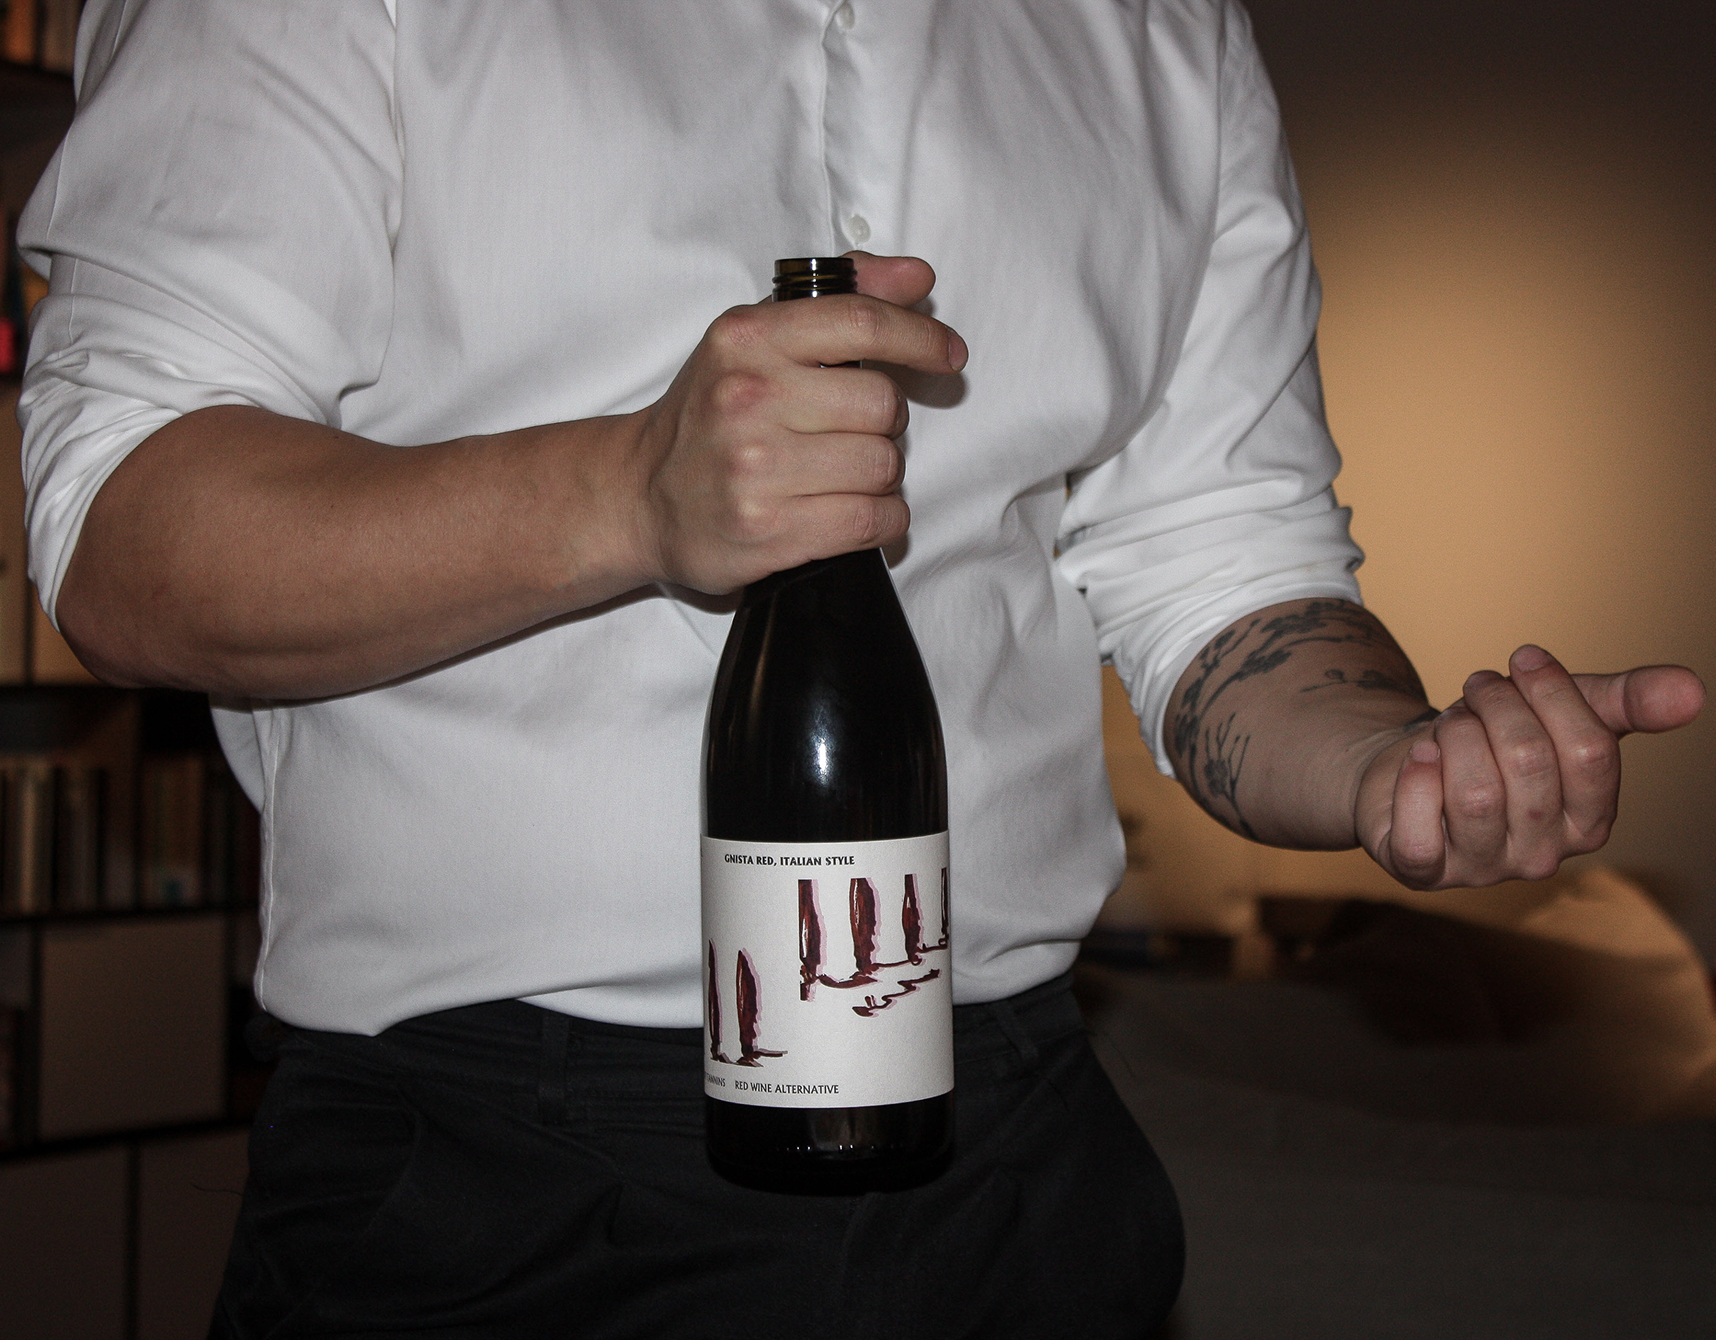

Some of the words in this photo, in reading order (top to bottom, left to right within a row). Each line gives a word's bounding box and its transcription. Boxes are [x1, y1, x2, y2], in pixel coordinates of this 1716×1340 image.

[724, 854, 754, 865] GNISTA
[756, 856, 777, 867] RED,
[780, 856, 822, 866] ITALIAN
[825, 855, 855, 866] STYLE
[734, 1080, 749, 1091] RED
[750, 1082, 772, 1093] WINE
[774, 1084, 839, 1094] ALTERNATIVE
